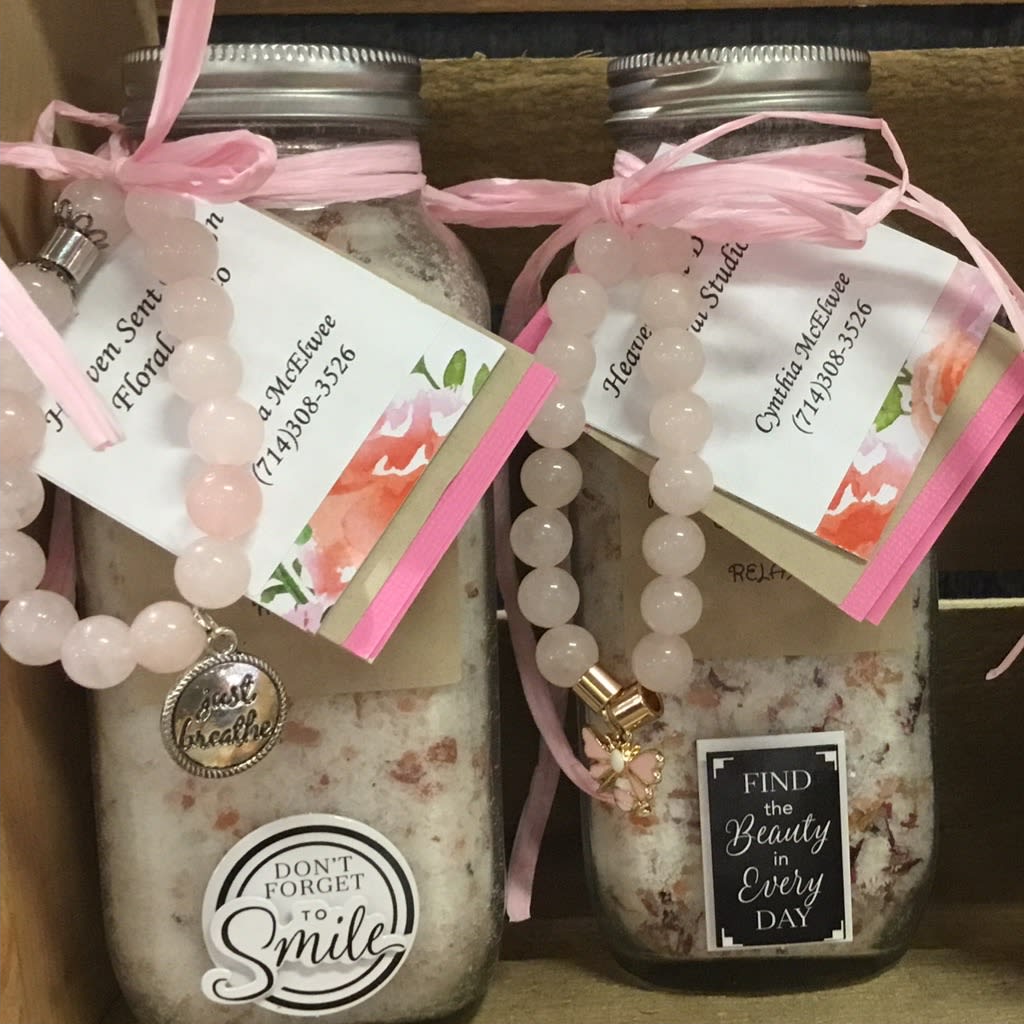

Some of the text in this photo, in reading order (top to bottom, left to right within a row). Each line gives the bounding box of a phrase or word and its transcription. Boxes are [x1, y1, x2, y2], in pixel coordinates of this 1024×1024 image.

[45, 286, 163, 433] Hven Sent
[112, 331, 176, 413] Floral
[266, 313, 338, 406] McElwee
[602, 324, 653, 398] Heave
[754, 271, 852, 435] Cynthia McElwee
[791, 298, 873, 436] (714)308-3526
[252, 344, 357, 487] (714)308-3526
[194, 673, 258, 724] just
[178, 709, 276, 752] breathe
[743, 769, 812, 794] FIND
[764, 801, 793, 817] the
[725, 813, 832, 857] Beauty
[274, 855, 354, 880] DON'T
[773, 851, 789, 866] in
[264, 873, 366, 900] FORGET
[737, 866, 825, 907] Every
[301, 908, 328, 921] TO
[755, 906, 813, 931] DAY
[212, 904, 407, 1001] Smile
